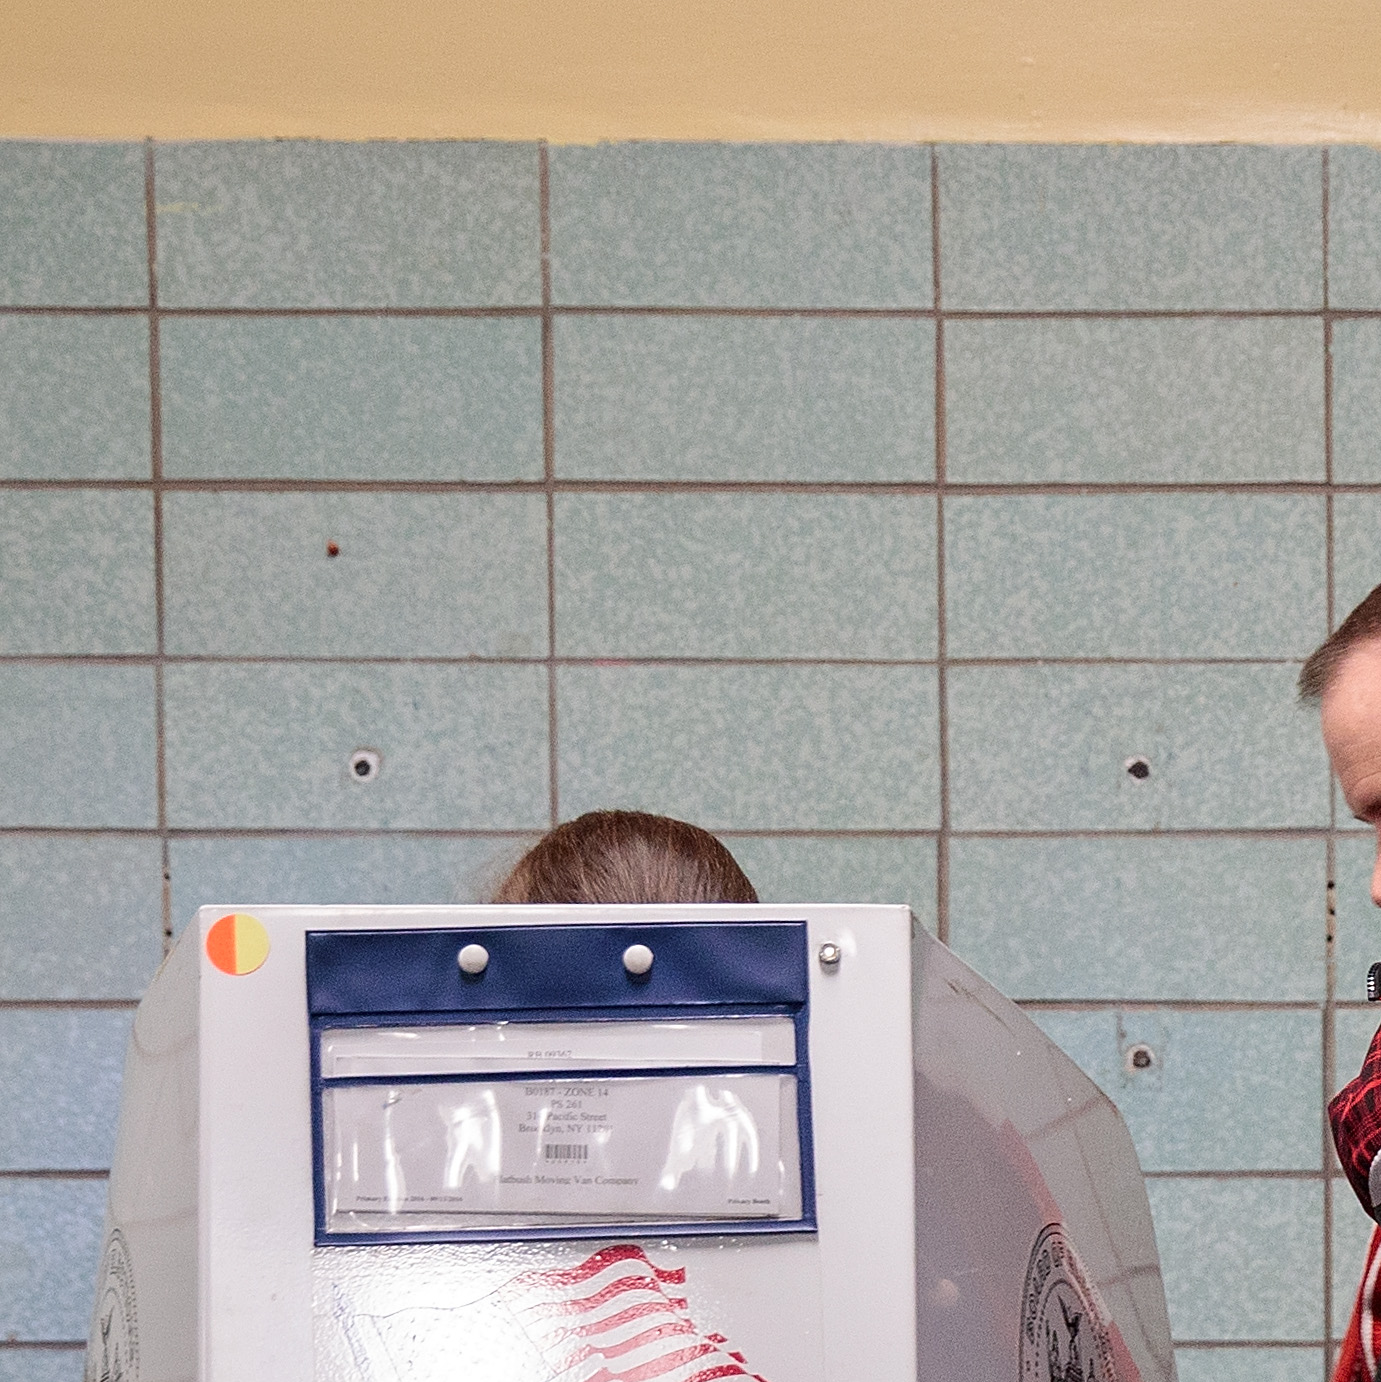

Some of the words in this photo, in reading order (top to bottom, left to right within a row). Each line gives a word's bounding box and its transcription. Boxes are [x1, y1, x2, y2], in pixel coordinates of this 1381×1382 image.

[564, 1087, 594, 1096] ZONE
[598, 1087, 608, 1096] 14
[551, 1100, 563, 1109] PS
[566, 1100, 582, 1109] 261
[547, 1111, 578, 1121] Pacific
[580, 1112, 607, 1121] Street
[567, 1124, 583, 1133] NY
